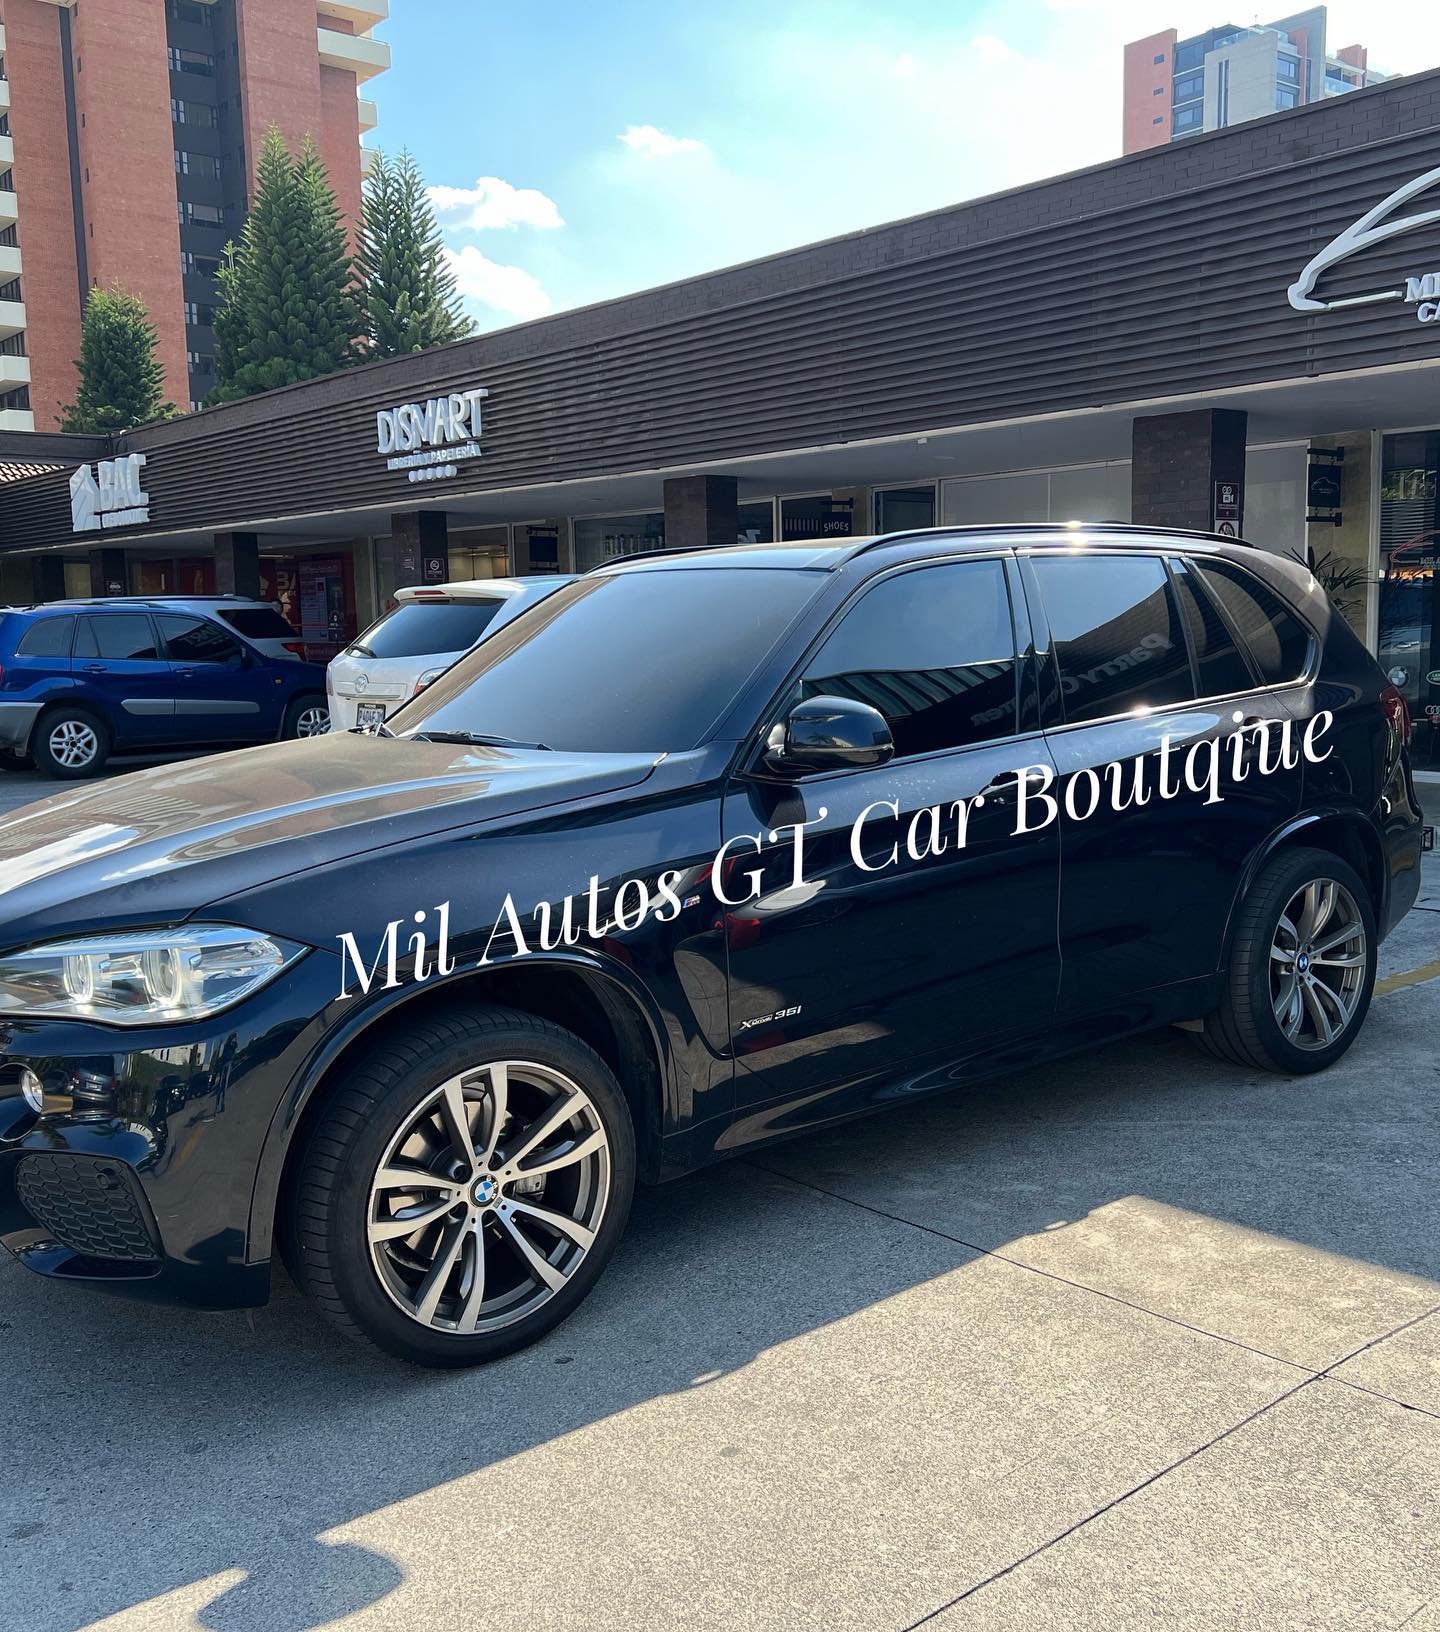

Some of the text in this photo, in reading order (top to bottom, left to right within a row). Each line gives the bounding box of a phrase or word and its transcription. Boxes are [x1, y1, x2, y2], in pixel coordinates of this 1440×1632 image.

[377, 388, 488, 453] DISMART
[98, 453, 149, 511] BAC
[823, 520, 849, 532] SHOES
